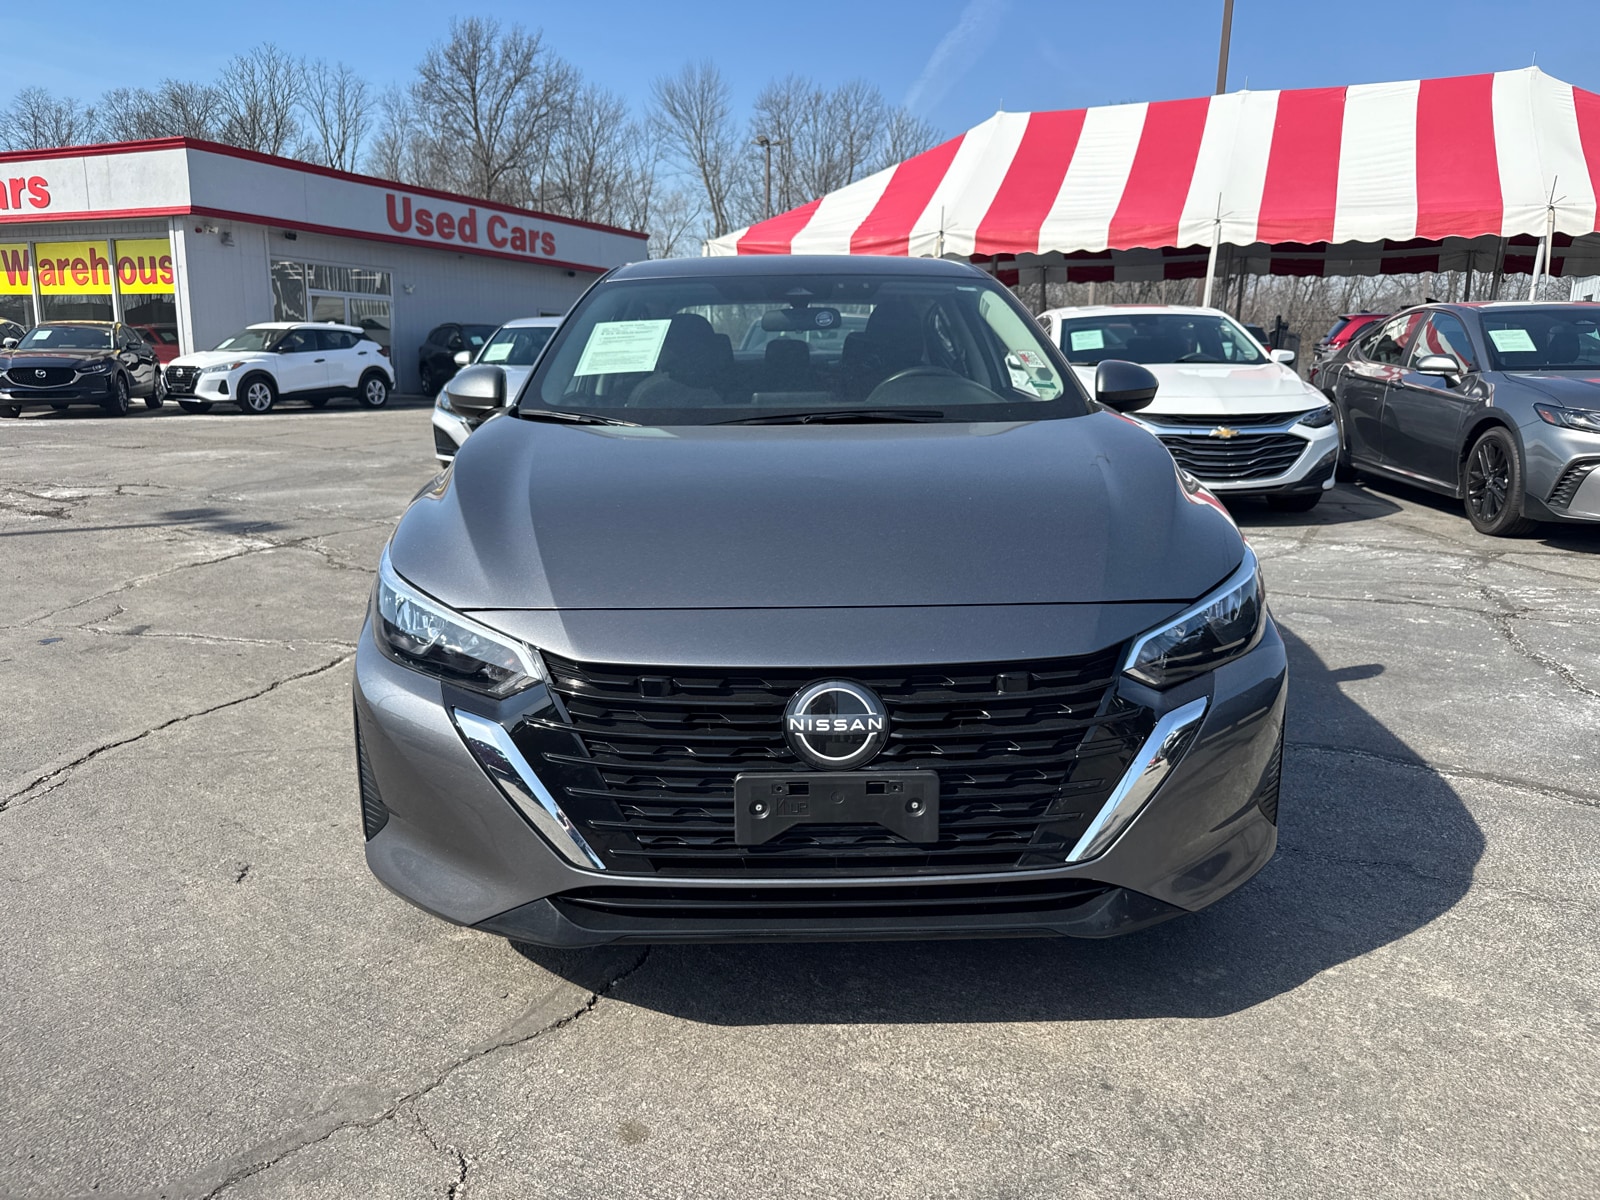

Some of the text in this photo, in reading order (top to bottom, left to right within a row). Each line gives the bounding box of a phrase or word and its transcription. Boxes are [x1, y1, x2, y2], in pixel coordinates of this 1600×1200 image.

[386, 193, 556, 256] Used Cars
[789, 717, 883, 732] NISSAN
